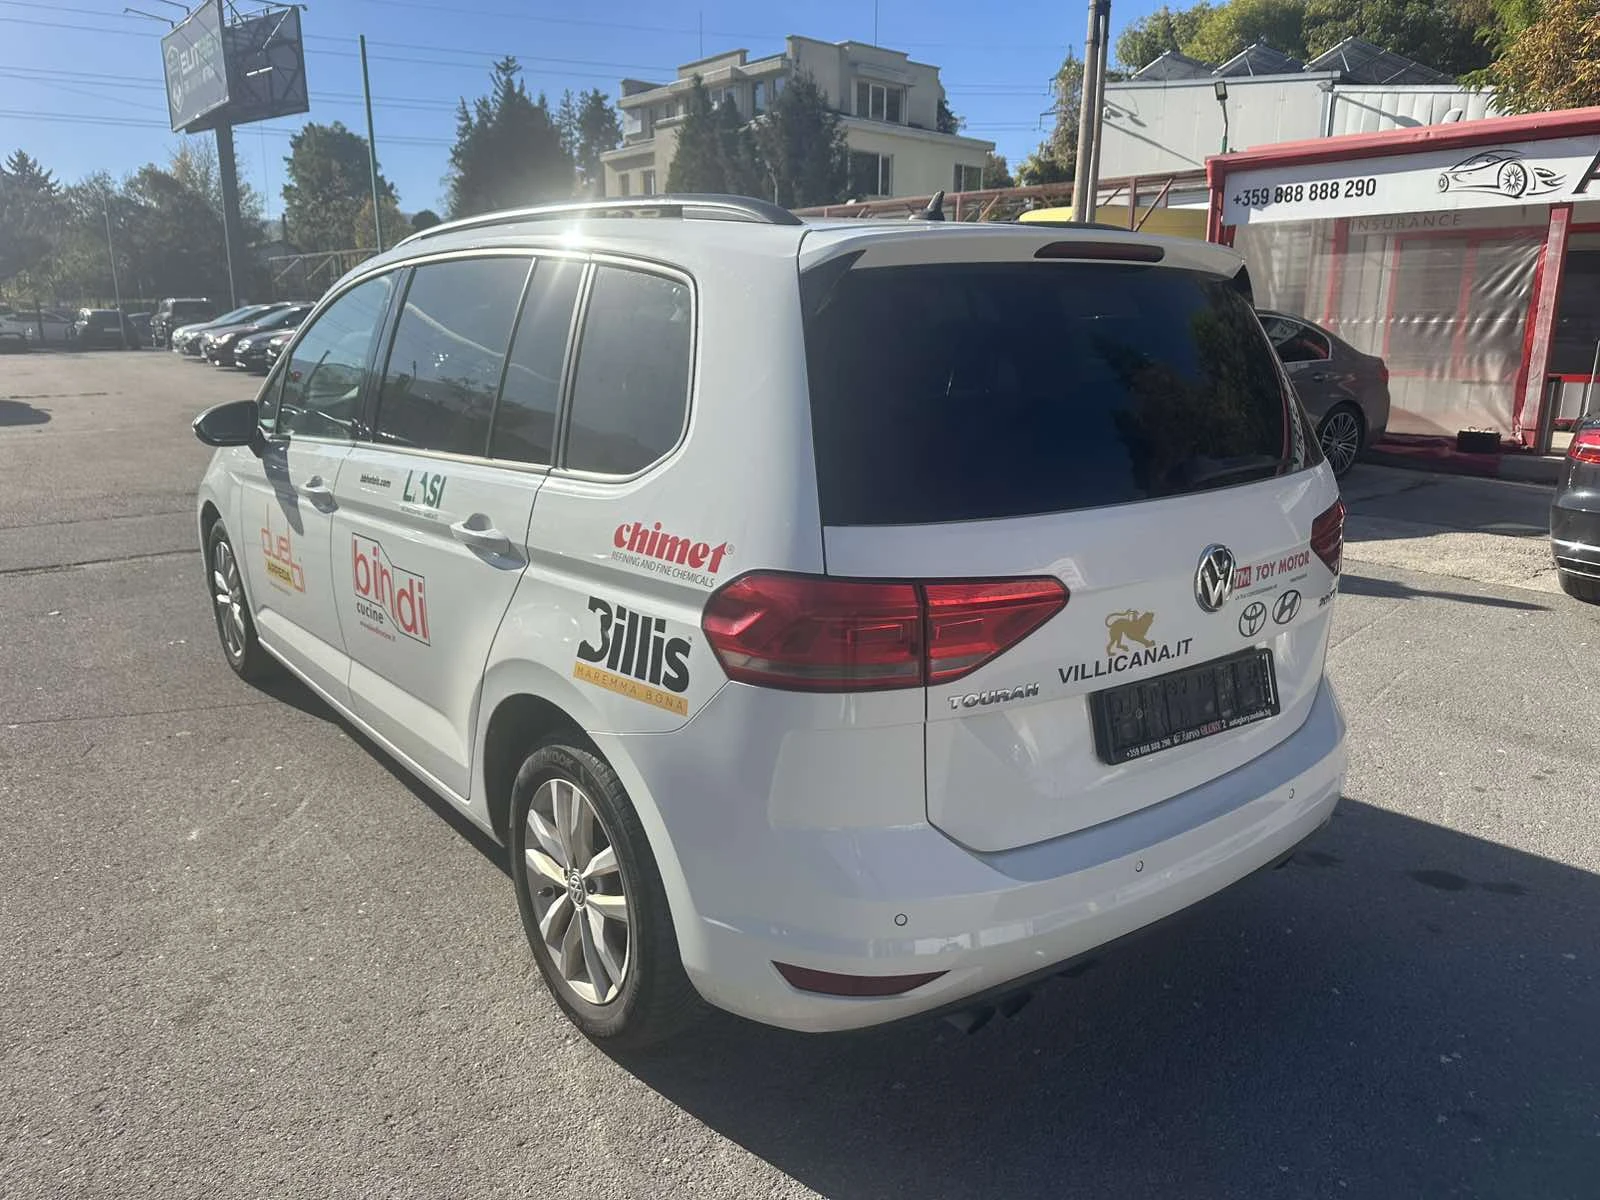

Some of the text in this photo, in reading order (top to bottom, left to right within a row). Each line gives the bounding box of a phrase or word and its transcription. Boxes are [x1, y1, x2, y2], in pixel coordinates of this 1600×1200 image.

[1233, 178, 1377, 207] +359 888 888 290
[1350, 213, 1463, 232] INSURANCE
[613, 521, 728, 574] chimet
[611, 551, 715, 588] REFINING AND FINE CHEMICALS
[1256, 561, 1276, 582] TOY
[1278, 550, 1310, 575] MOTOR
[353, 539, 428, 640] bindi
[356, 602, 384, 624] cucine
[1058, 638, 1193, 684] VILLICANA.IT
[576, 664, 685, 712] MAREMMA BONA
[949, 682, 1039, 709] TOURAN
